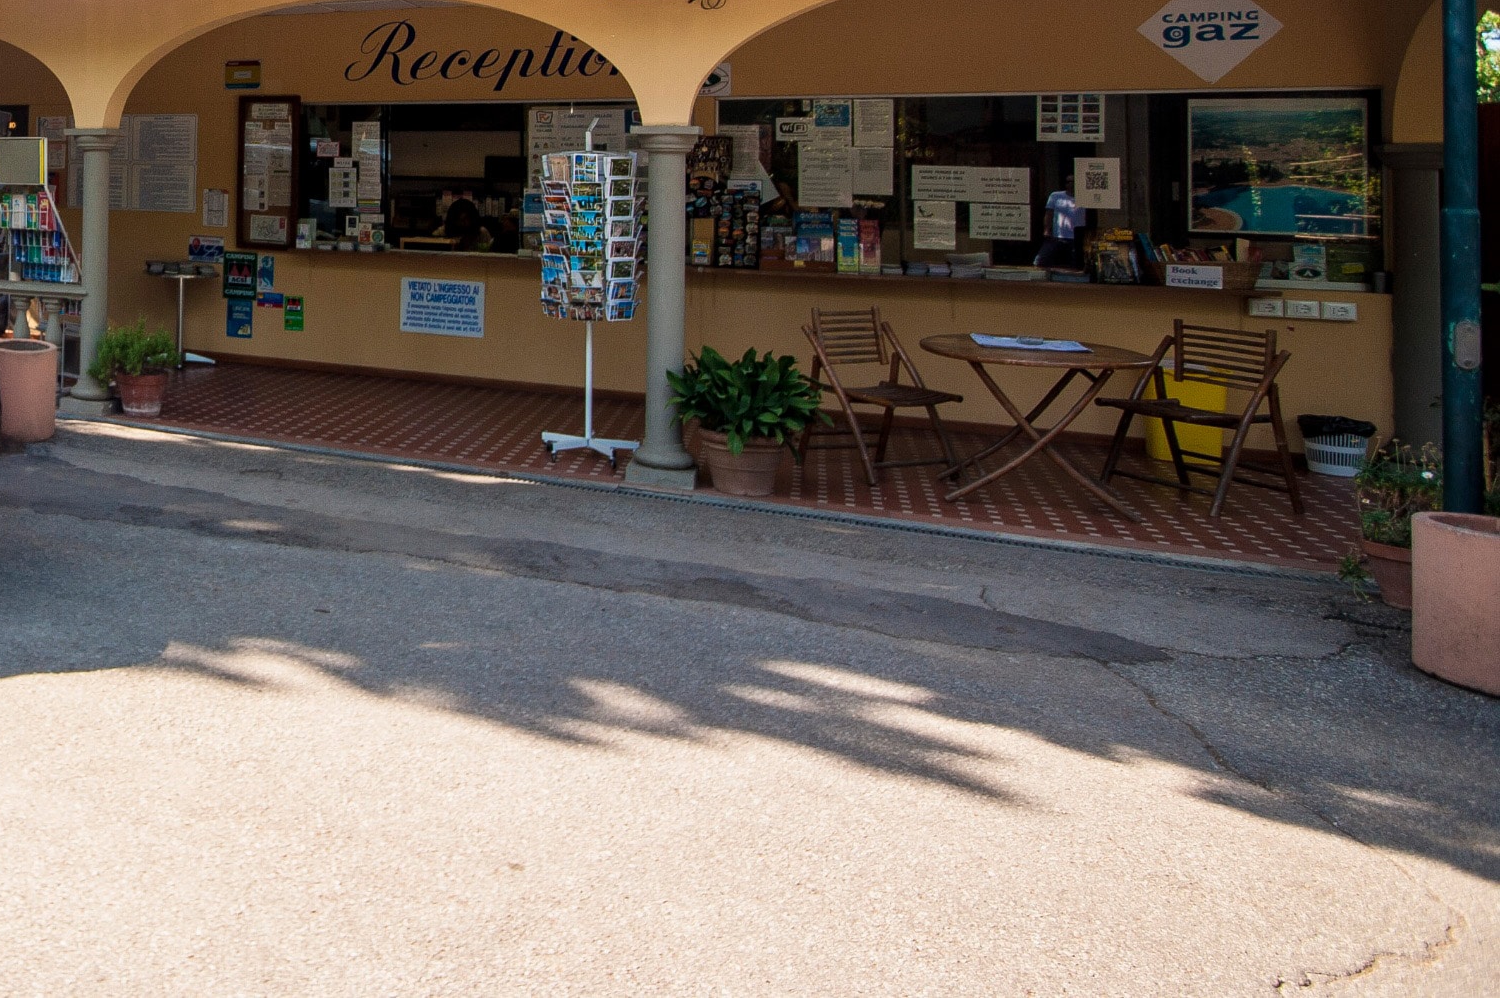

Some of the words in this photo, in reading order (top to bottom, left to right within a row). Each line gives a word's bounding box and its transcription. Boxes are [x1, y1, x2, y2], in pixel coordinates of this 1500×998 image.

[1161, 10, 1259, 23] CAMPING
[1162, 23, 1260, 48] gaz
[344, 18, 619, 92] Receptio
[1171, 266, 1198, 275] Book
[408, 281, 432, 292] VIETATO
[1170, 276, 1219, 287] exchange
[410, 292, 424, 302] NON
